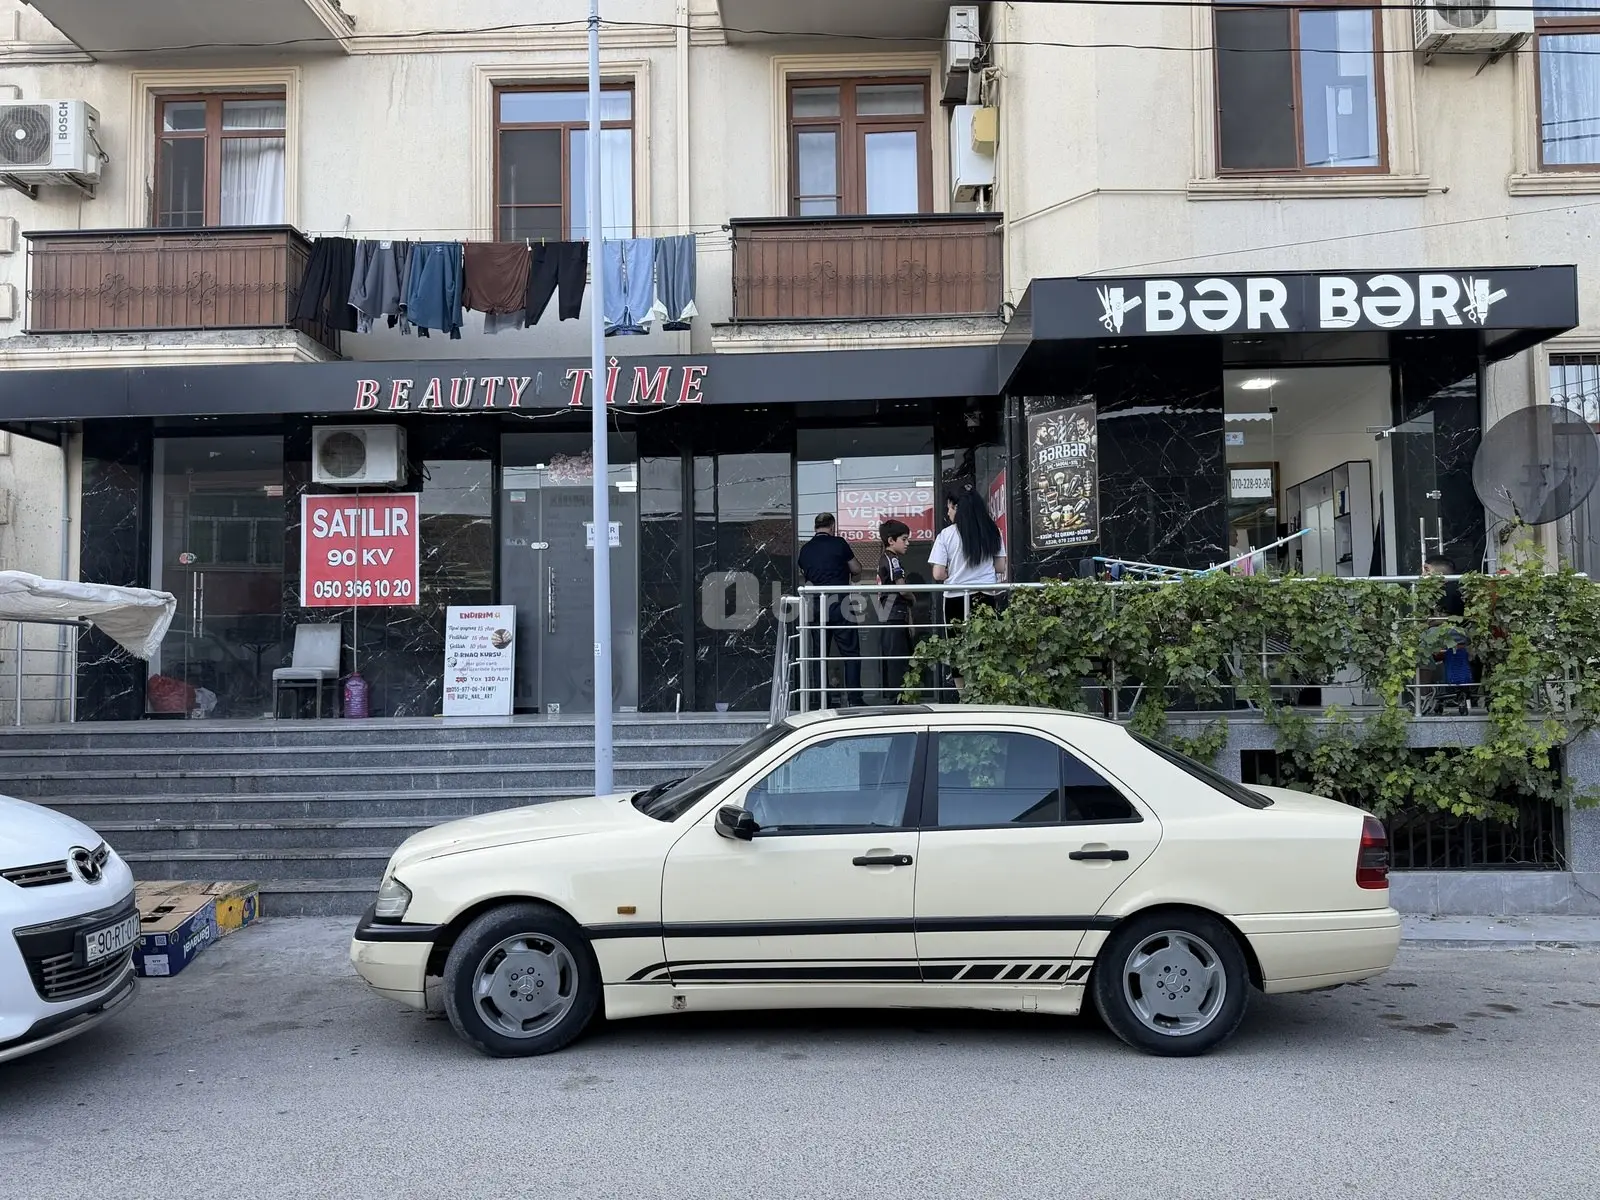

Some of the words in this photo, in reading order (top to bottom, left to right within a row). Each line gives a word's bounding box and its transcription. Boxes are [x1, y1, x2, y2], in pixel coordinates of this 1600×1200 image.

[59, 102, 68, 140] BOSCH
[1145, 277, 1290, 332] BƏR
[1319, 274, 1463, 328] BƏR
[352, 376, 532, 410] BEAUTY
[565, 356, 708, 407] TİME
[1231, 477, 1271, 490] 070-228-92-90
[840, 488, 930, 504] İCARƏYƏ
[846, 503, 925, 519] VERİLİR
[312, 507, 410, 538] SATILIR
[840, 530, 864, 540] 050
[916, 529, 933, 539] 20
[327, 549, 357, 566] 90
[362, 548, 394, 566] KV
[314, 580, 342, 598] 050
[344, 580, 372, 598] 366
[375, 579, 390, 597] 10
[393, 579, 411, 597] 20
